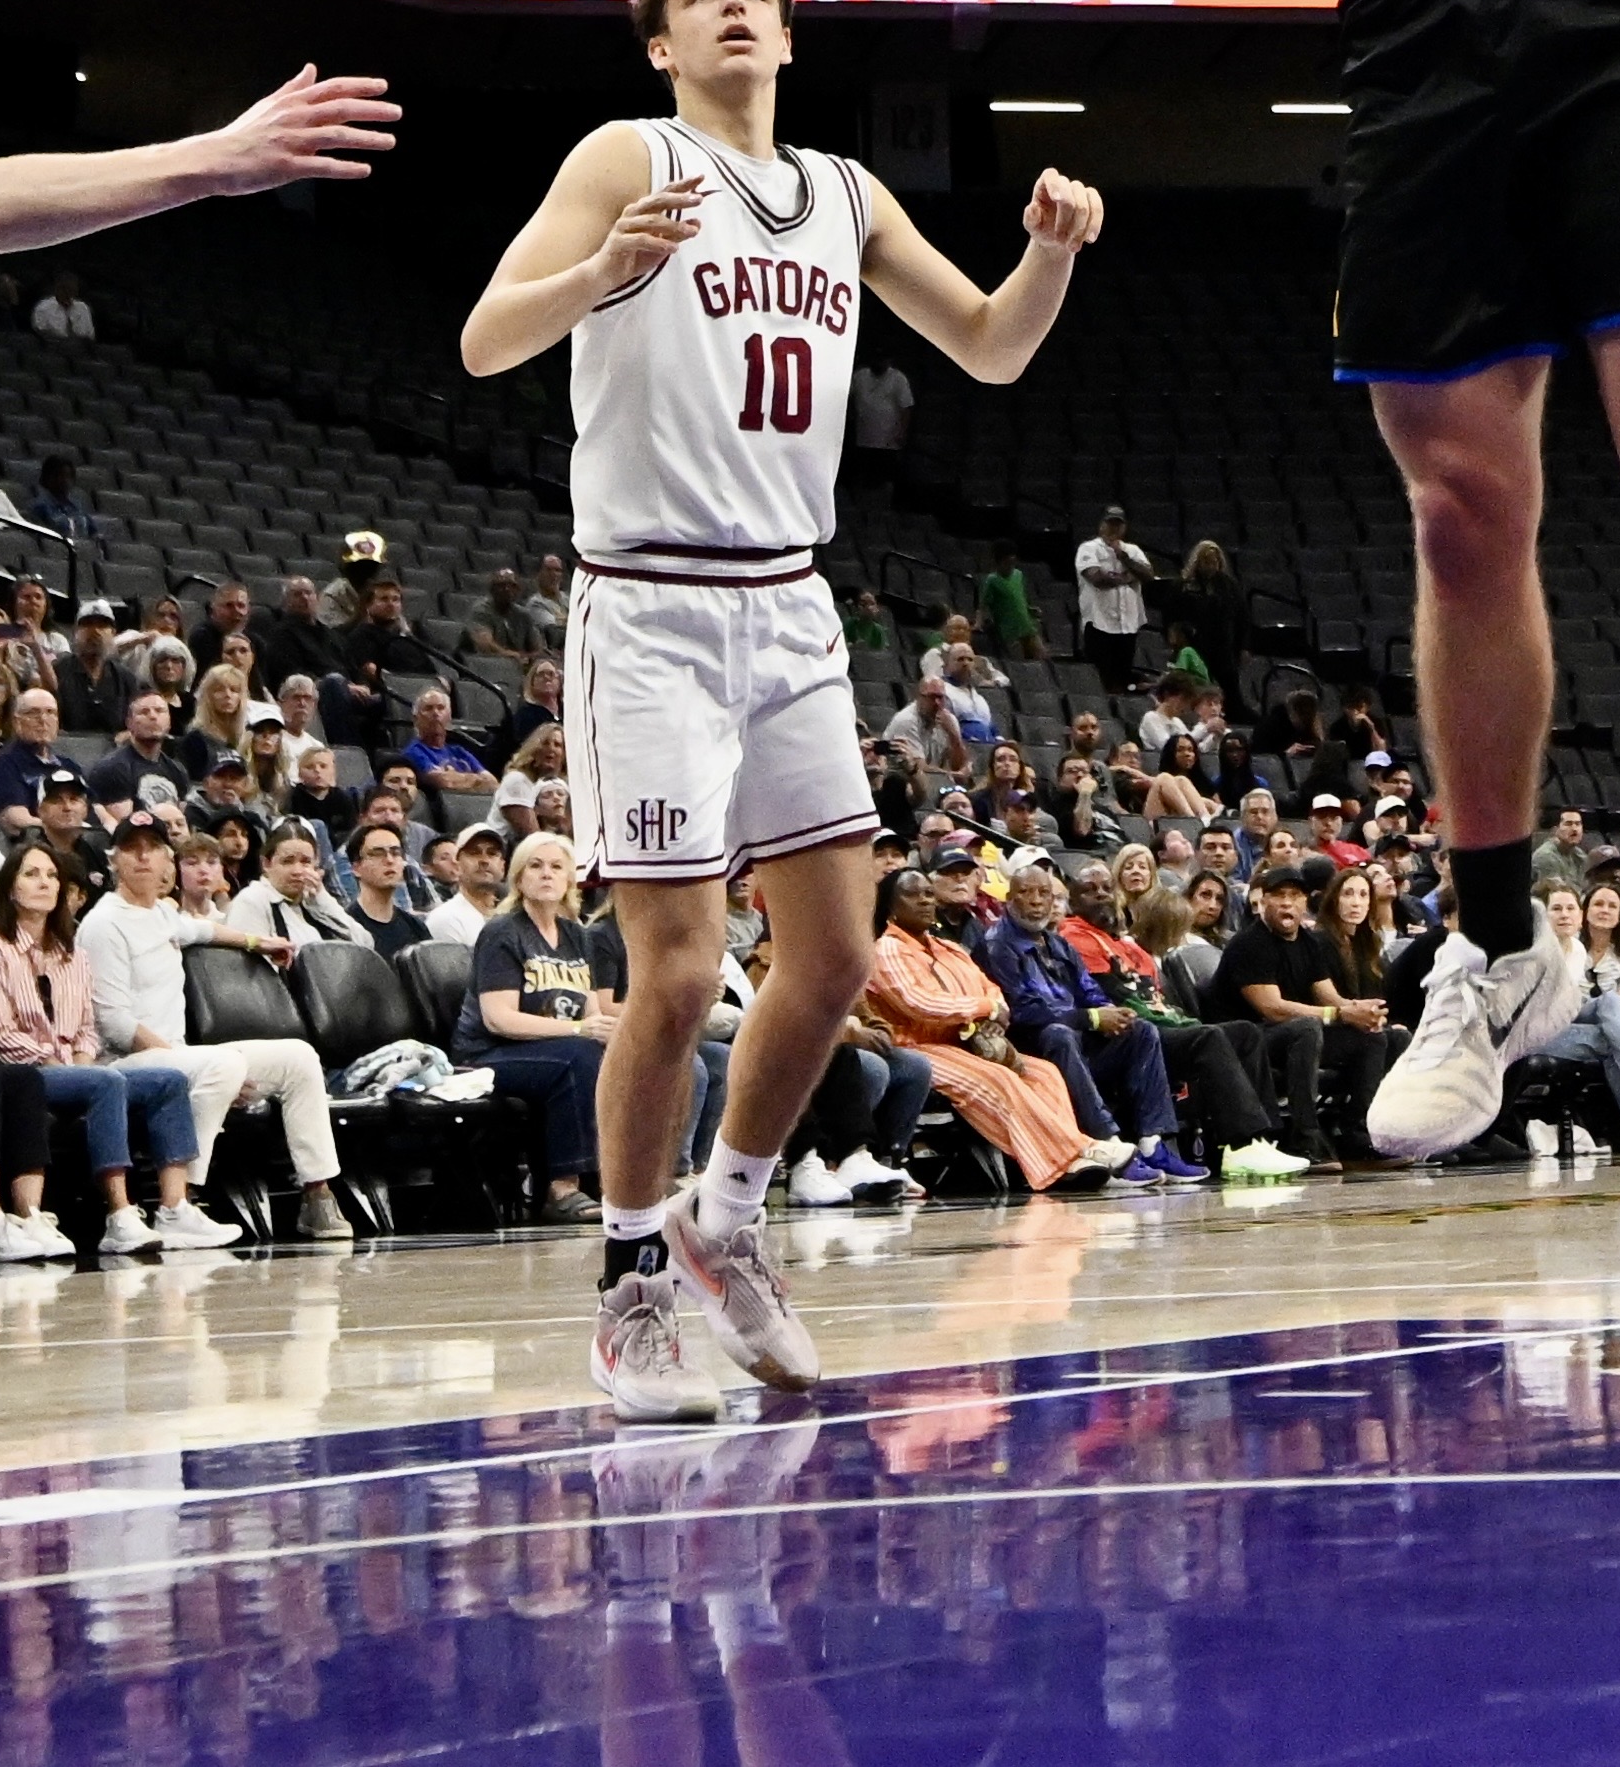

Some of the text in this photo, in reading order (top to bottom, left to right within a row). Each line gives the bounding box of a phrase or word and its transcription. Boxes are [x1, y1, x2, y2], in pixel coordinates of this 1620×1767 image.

[693, 256, 852, 337] GATORS
[737, 332, 813, 435] 10
[625, 797, 689, 851] SHP
